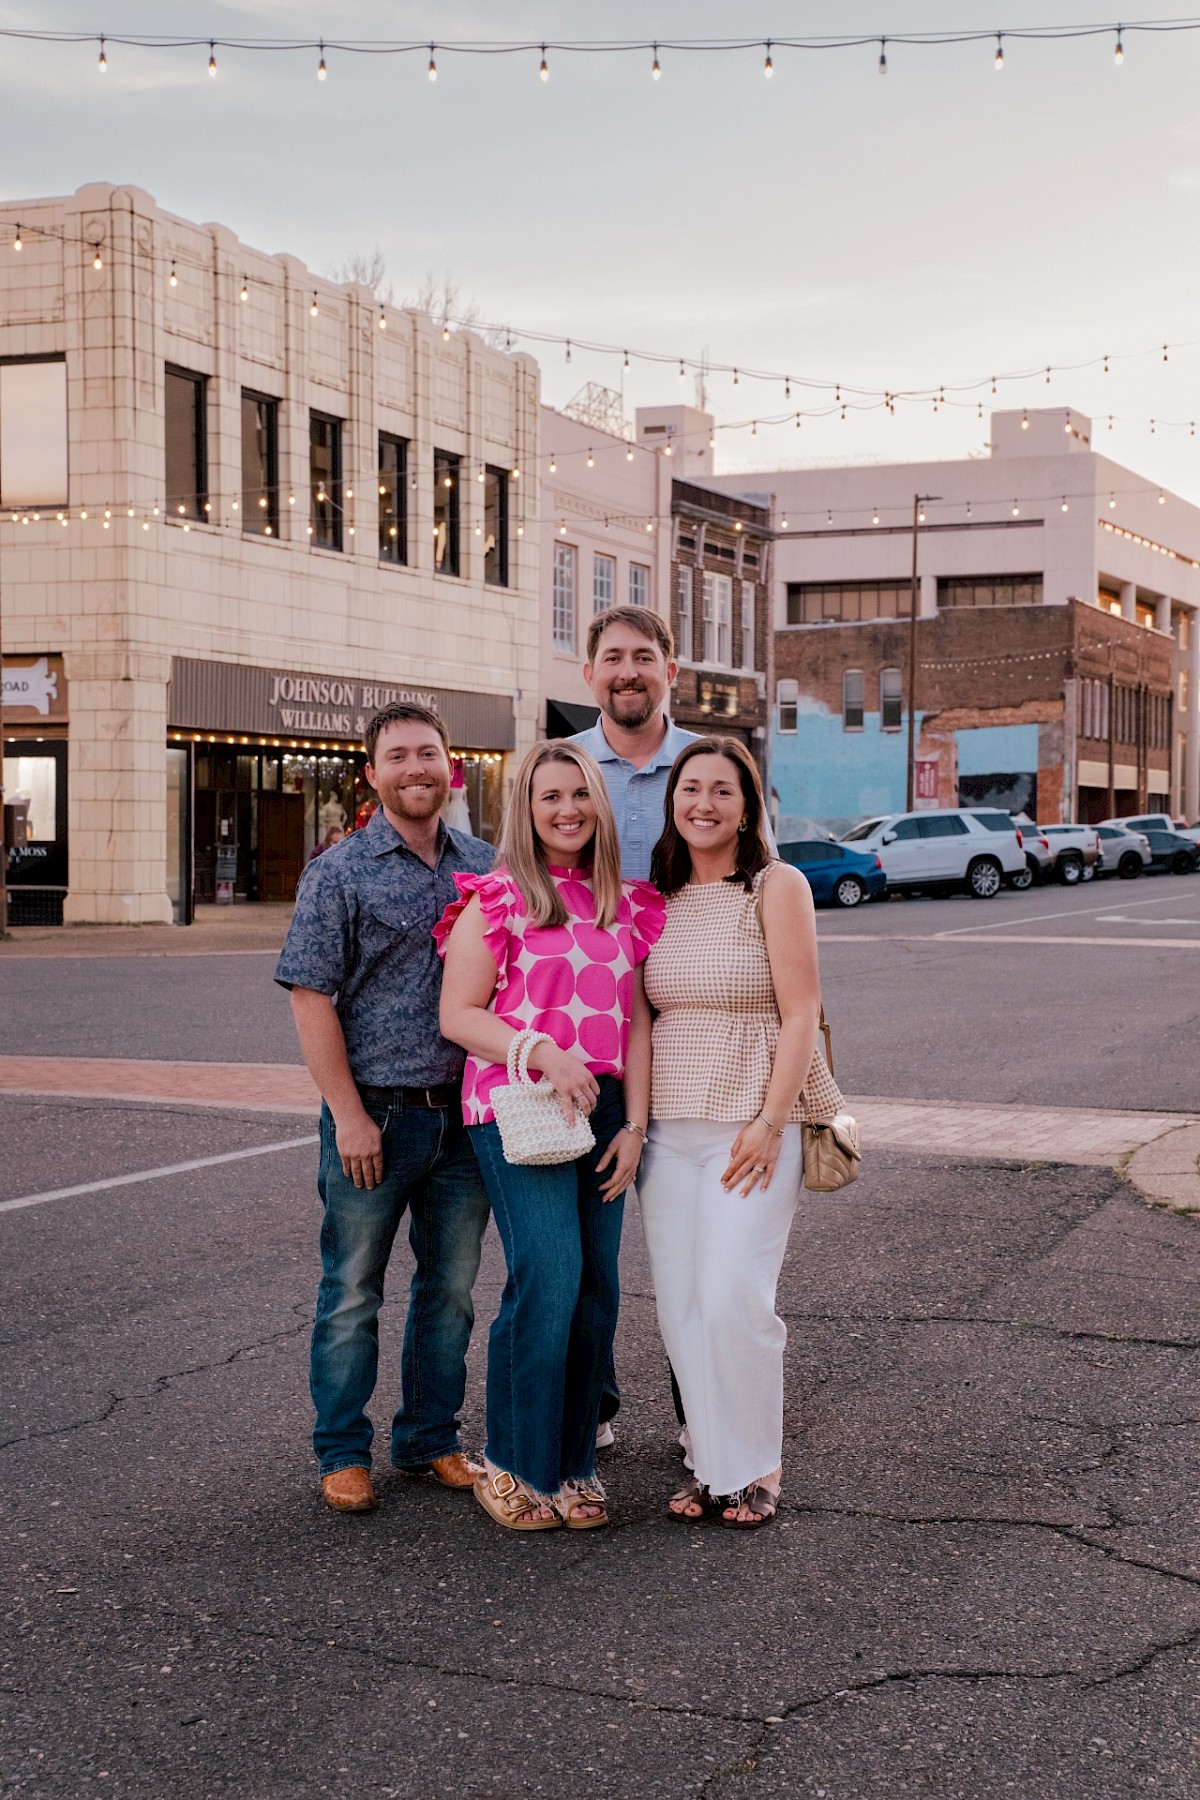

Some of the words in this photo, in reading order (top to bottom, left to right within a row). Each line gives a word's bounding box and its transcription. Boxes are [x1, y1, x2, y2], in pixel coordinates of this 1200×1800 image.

[1, 681, 29, 692] OAD
[269, 676, 355, 706] JOHNSON
[280, 709, 350, 733] WILLIAMS
[355, 715, 366, 734] &
